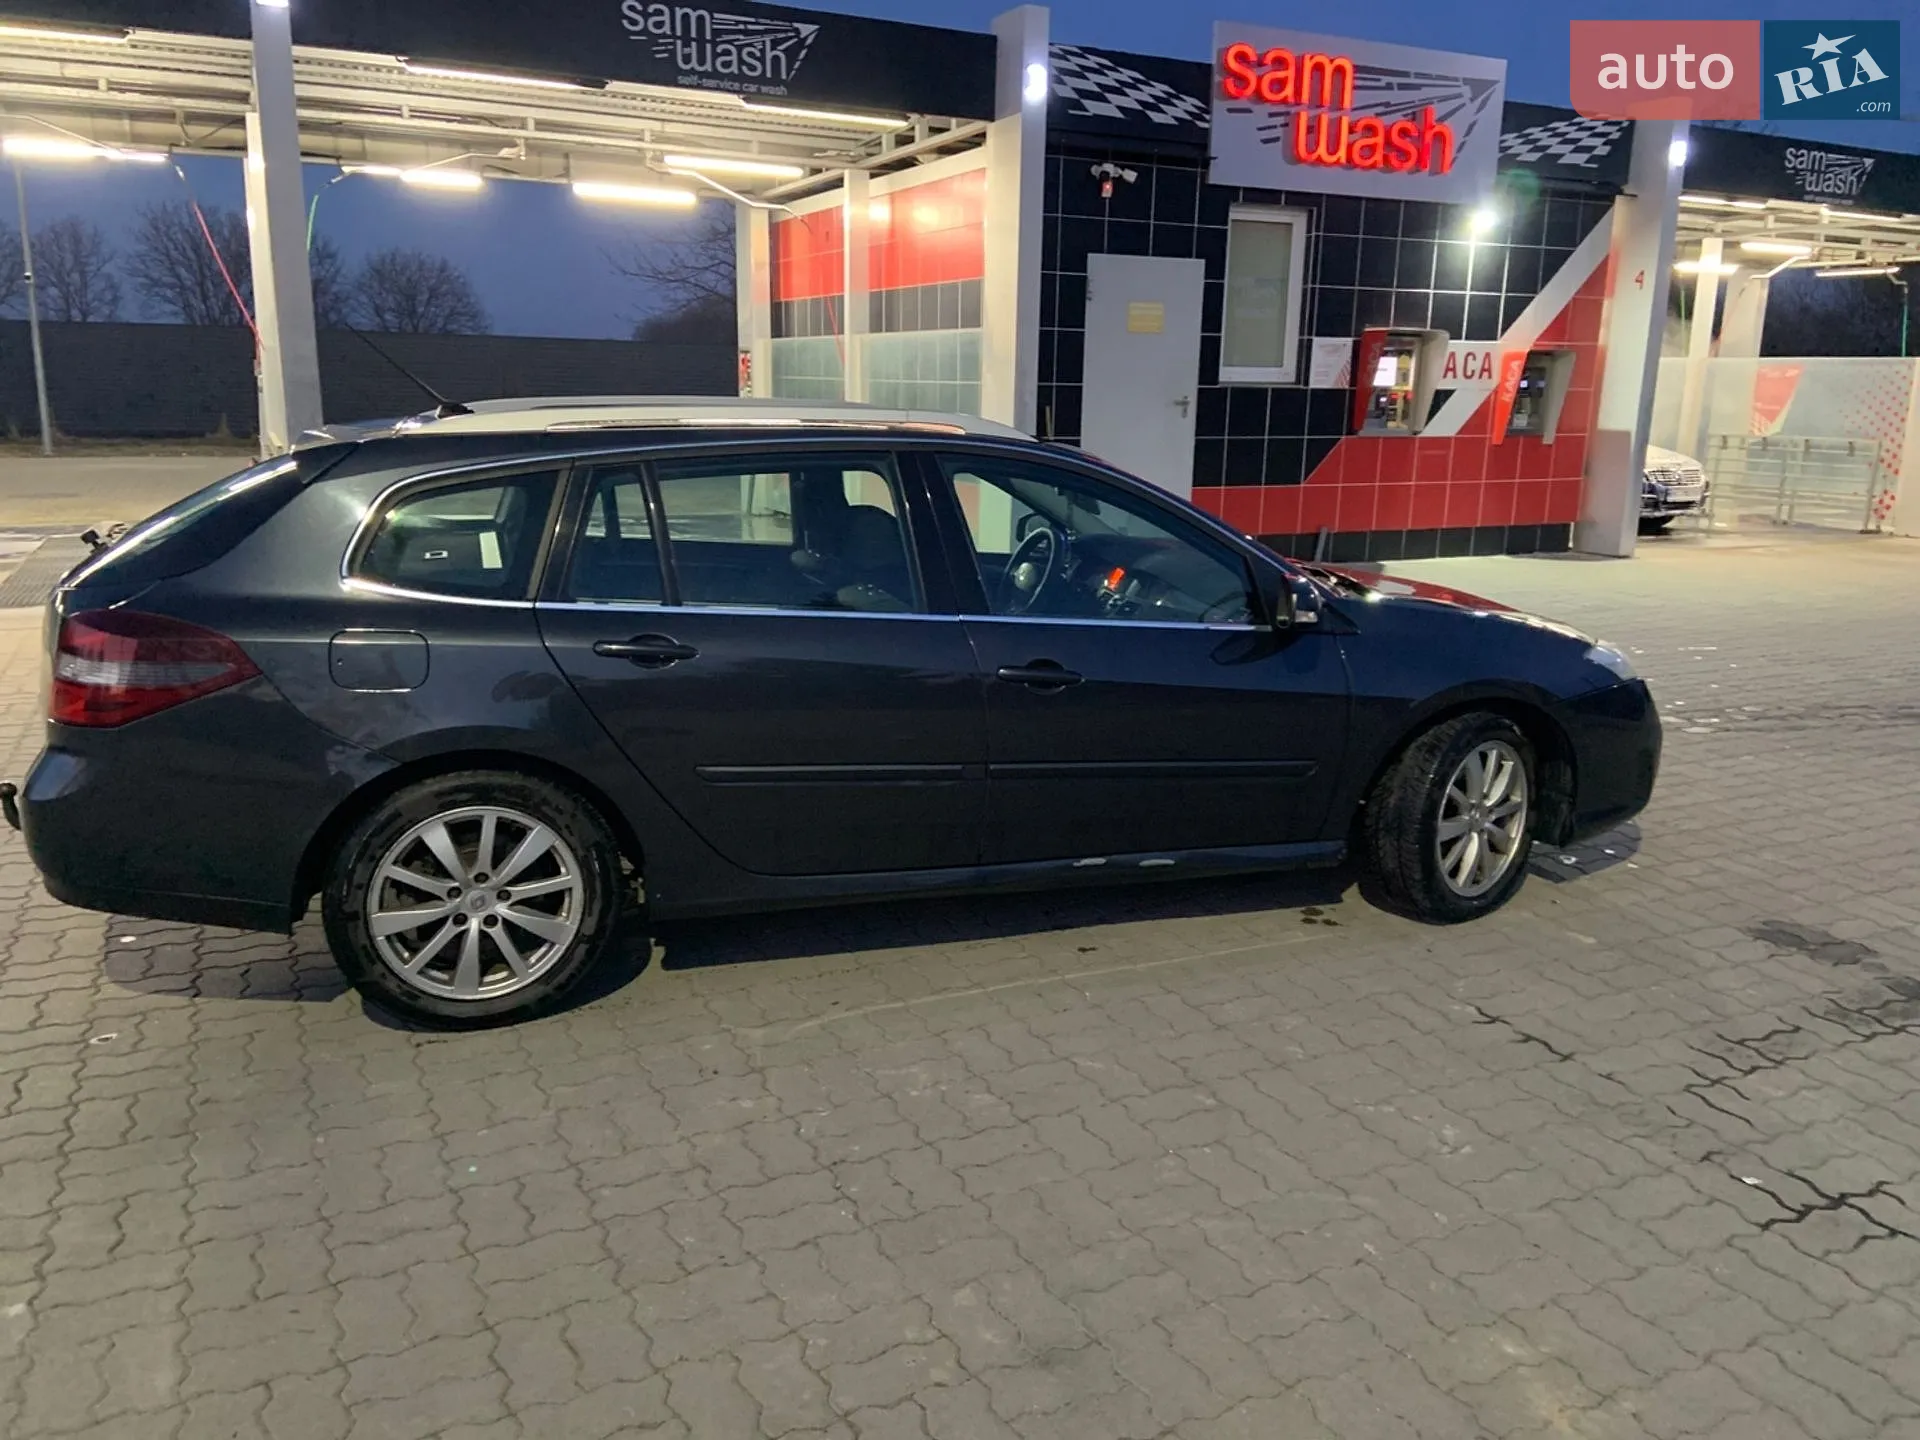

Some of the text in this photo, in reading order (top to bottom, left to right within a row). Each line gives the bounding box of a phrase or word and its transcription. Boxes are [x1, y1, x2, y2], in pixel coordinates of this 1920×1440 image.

[621, 0, 712, 40] sam
[676, 39, 788, 80] wash
[1222, 42, 1355, 110] sam
[1294, 104, 1454, 175] wash
[1784, 147, 1826, 171] sam
[1804, 170, 1857, 195] wash
[1634, 269, 1645, 290] 4
